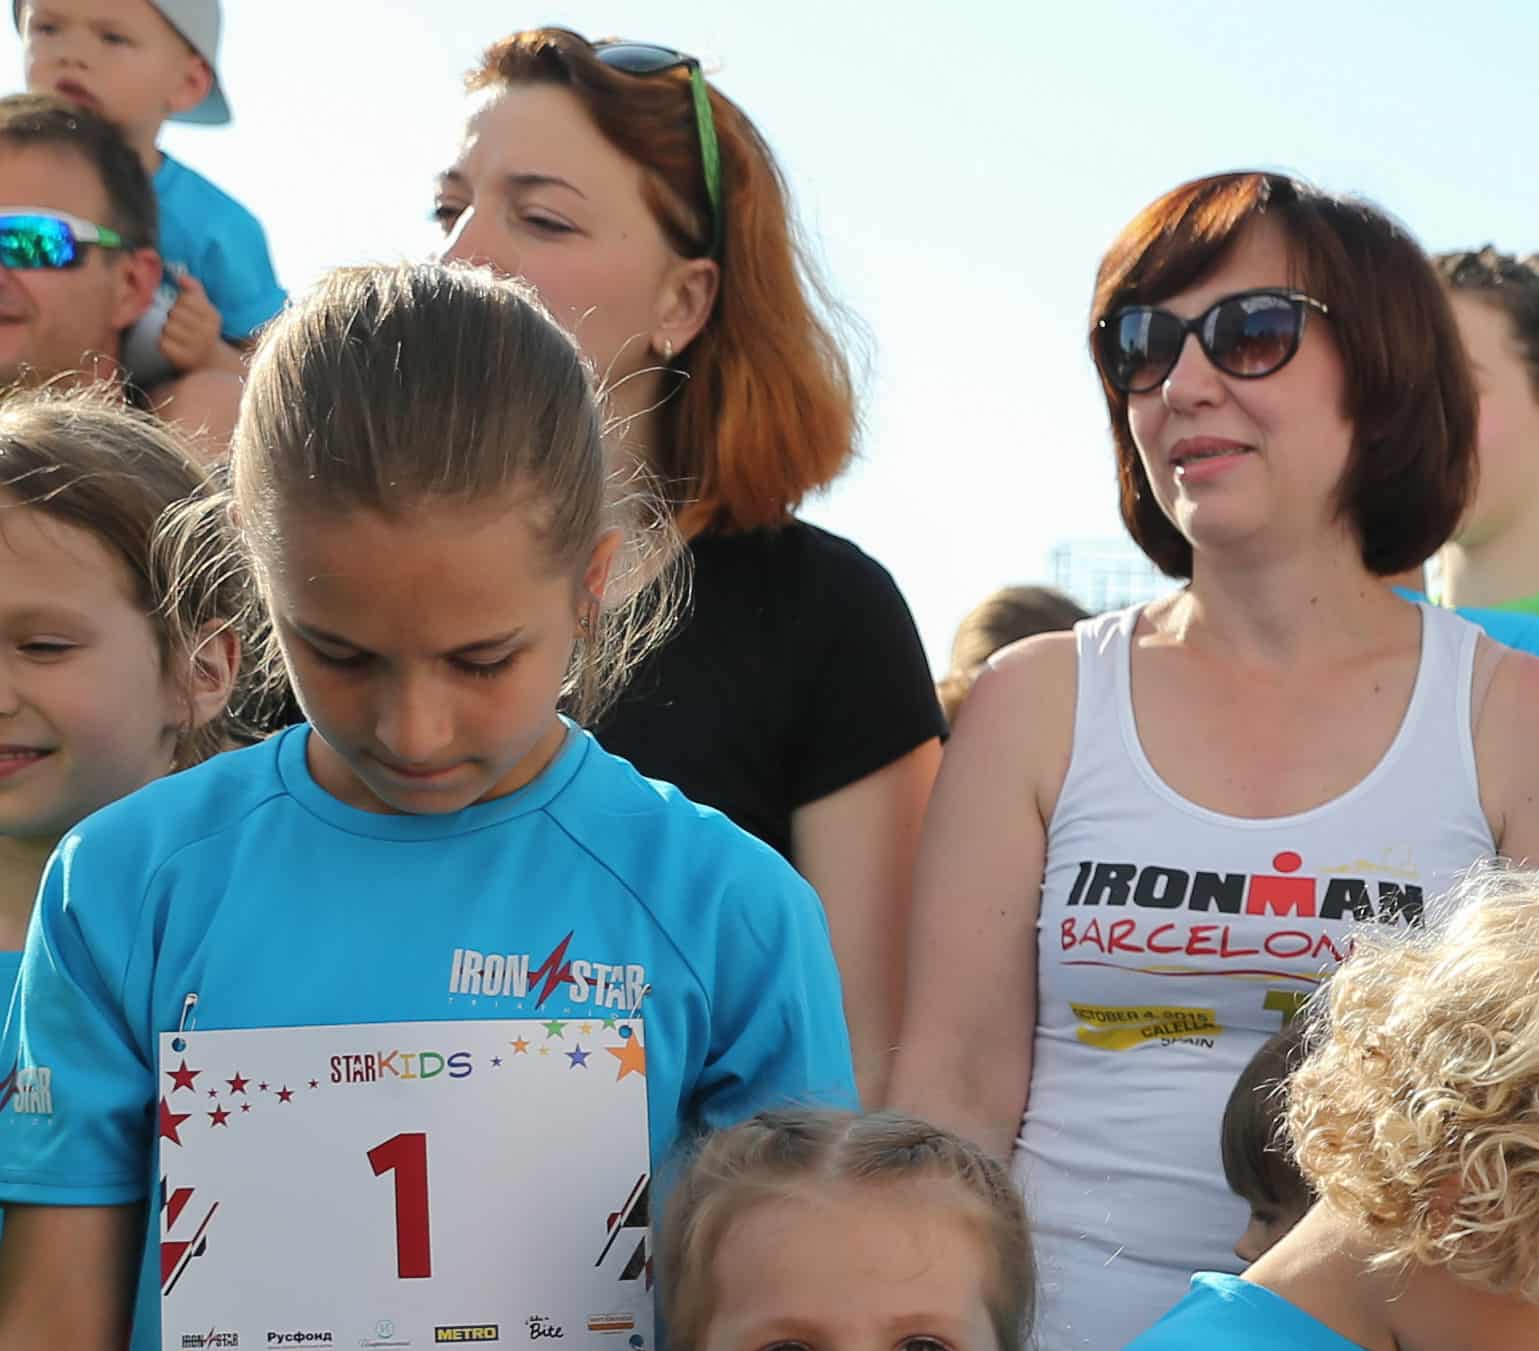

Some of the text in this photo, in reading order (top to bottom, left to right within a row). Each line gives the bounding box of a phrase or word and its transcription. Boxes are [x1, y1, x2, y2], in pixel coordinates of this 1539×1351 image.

[1066, 851, 1425, 929] IRONMAN
[1060, 917, 1356, 962] BARCELON
[330, 1050, 473, 1083] STARKIDS
[366, 1132, 431, 1279] 1
[267, 1331, 333, 1344] Русфонд
[437, 1327, 497, 1341] METRO
[529, 1324, 564, 1340] Bite
